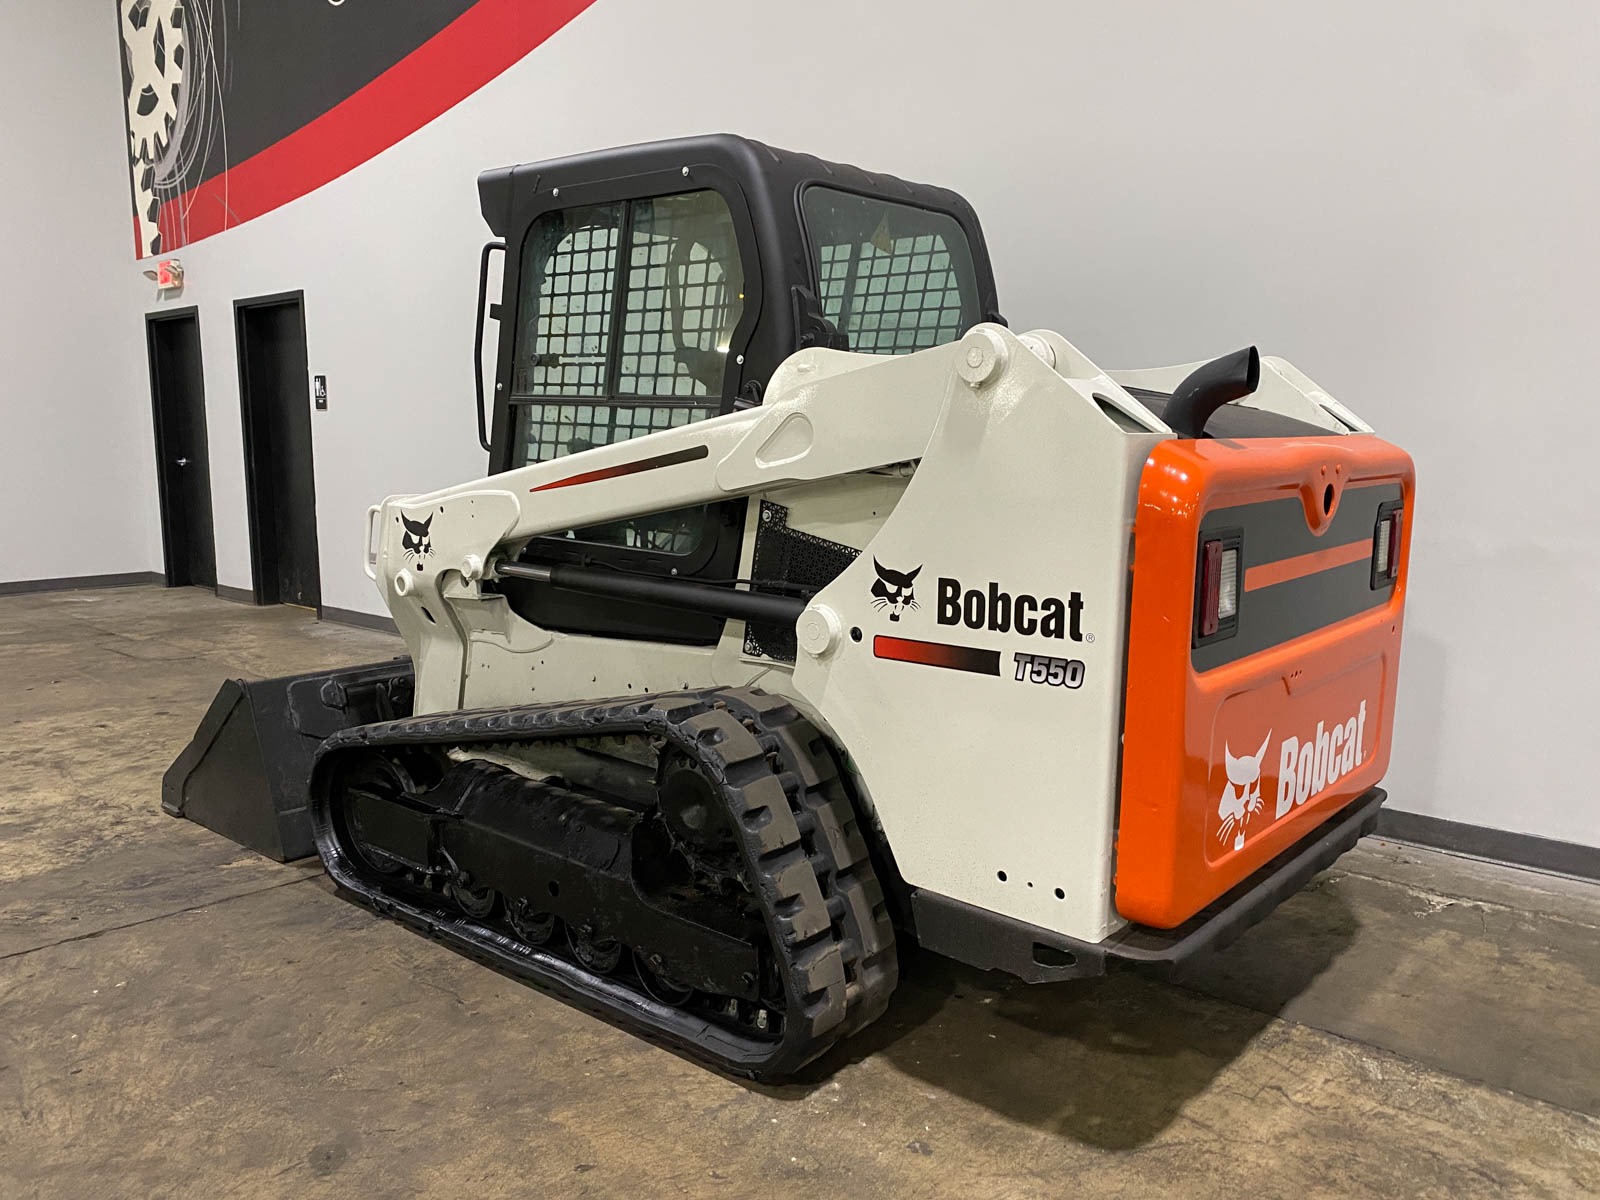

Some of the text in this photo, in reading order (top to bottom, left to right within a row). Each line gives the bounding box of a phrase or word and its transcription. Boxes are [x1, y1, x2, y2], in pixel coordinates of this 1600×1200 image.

[937, 577, 1084, 642] Bobcat
[1014, 652, 1085, 689] T550
[1275, 699, 1367, 820] Bobcat
